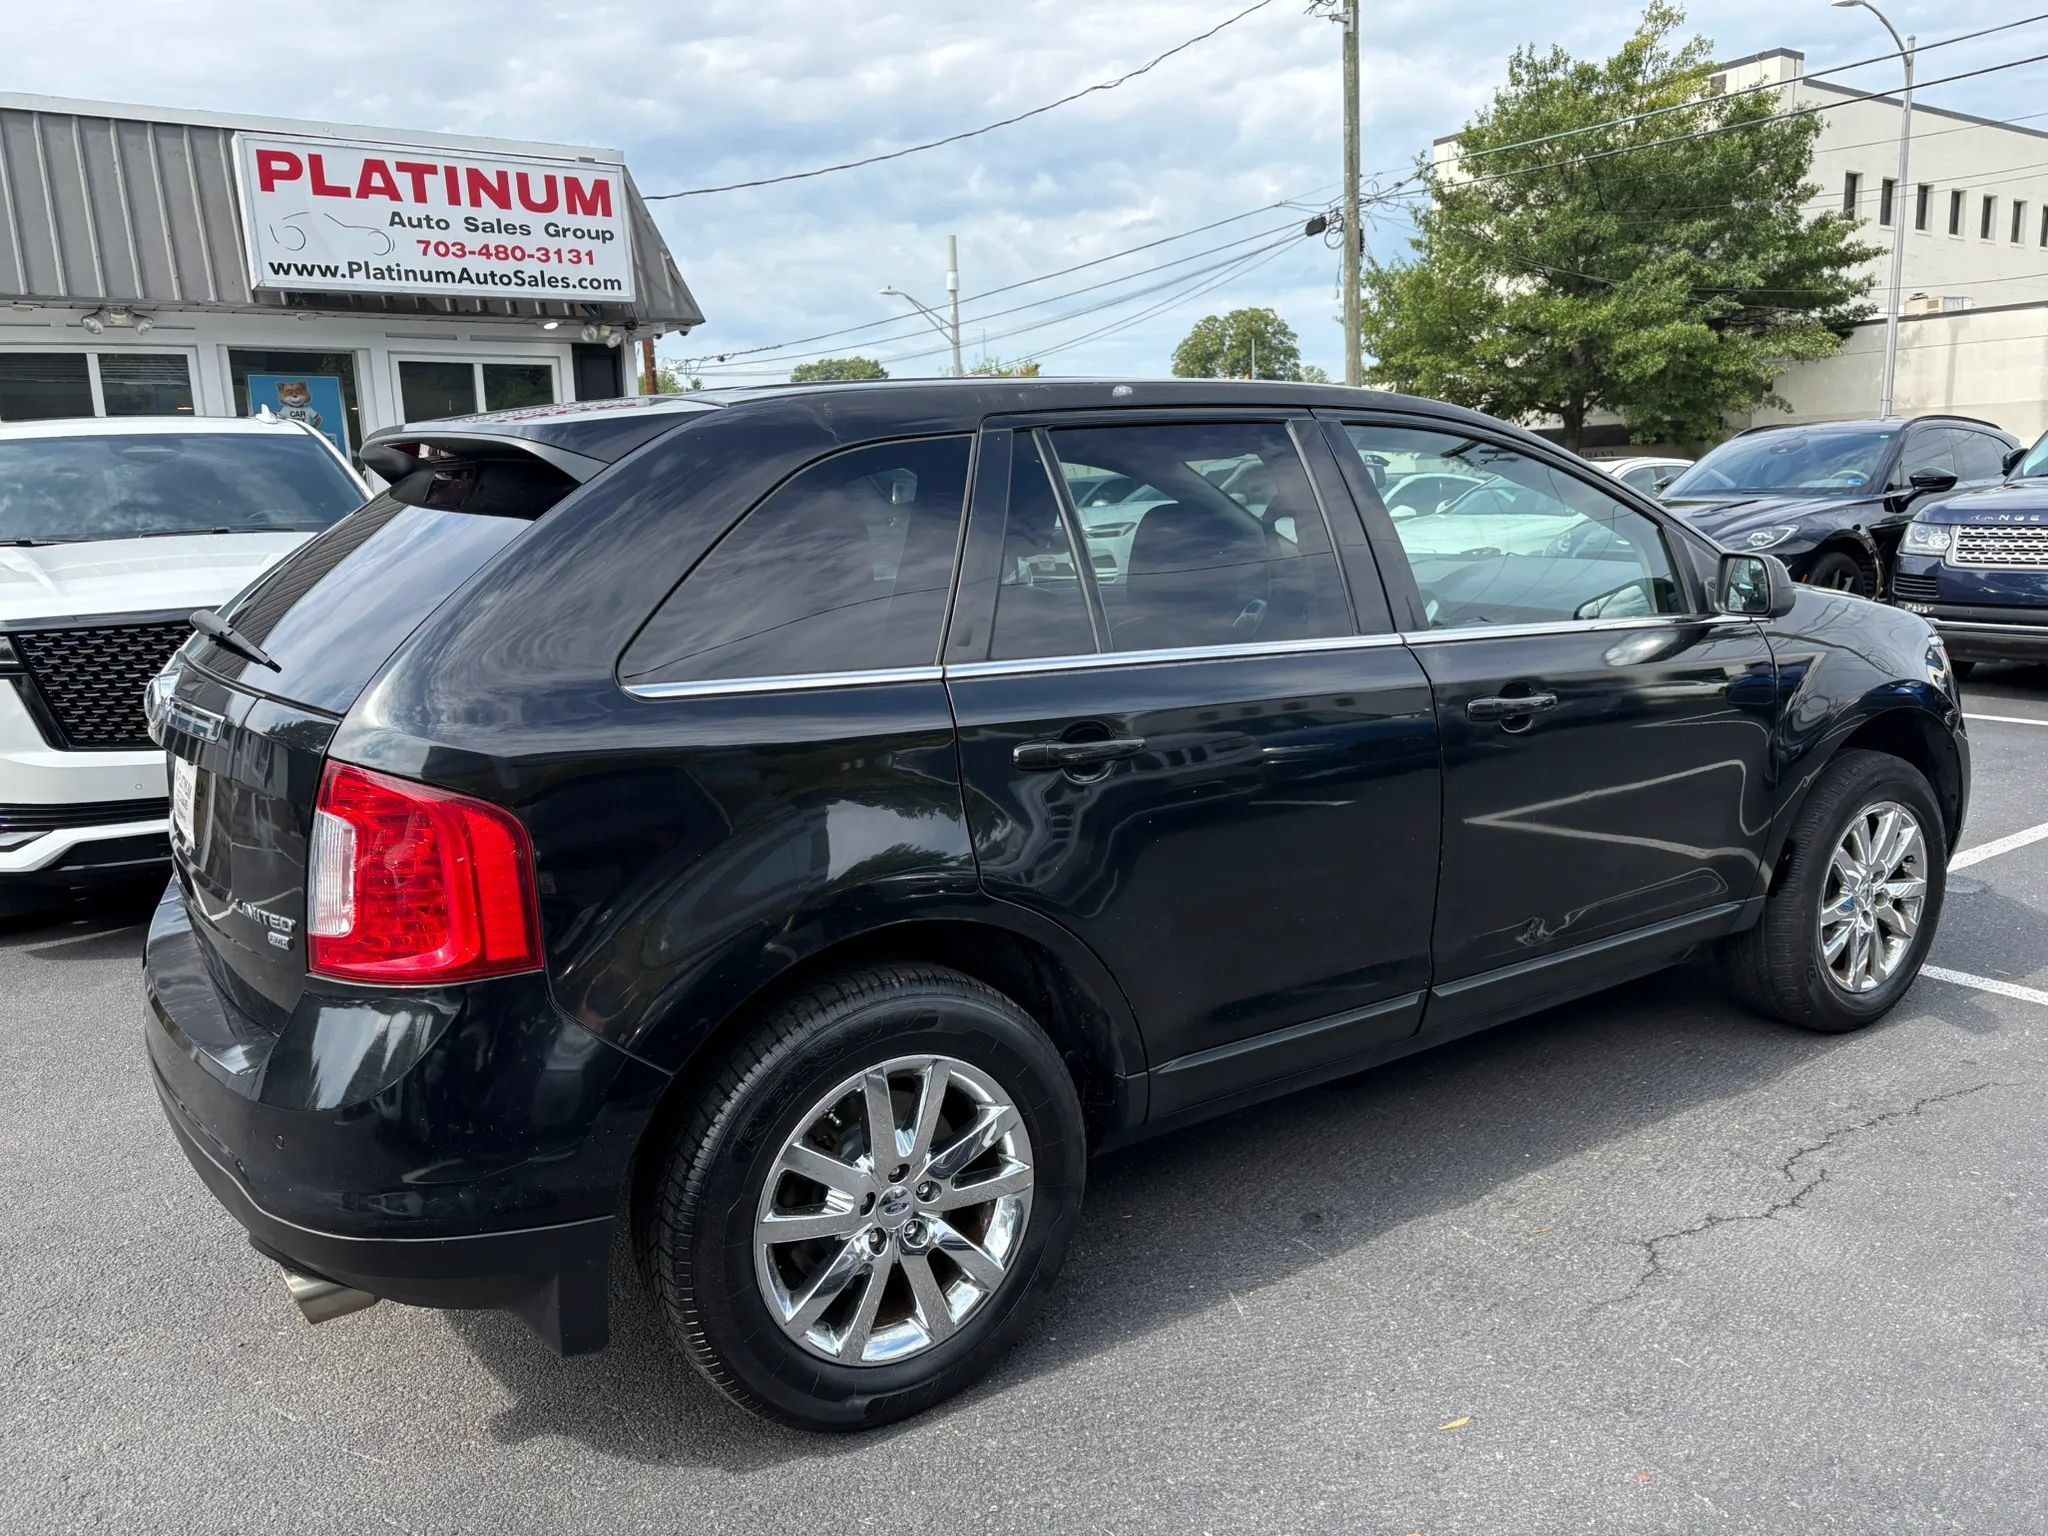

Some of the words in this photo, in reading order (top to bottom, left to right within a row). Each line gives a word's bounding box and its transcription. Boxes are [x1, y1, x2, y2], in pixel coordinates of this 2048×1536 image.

[255, 148, 613, 218] PLATINUM
[388, 210, 450, 232] Auto
[464, 216, 532, 237] Sales
[544, 222, 615, 244] Group
[416, 239, 595, 266] 703-480-3131
[268, 259, 622, 291] www.PlatinumAutoSales.com
[289, 410, 306, 418] CAR
